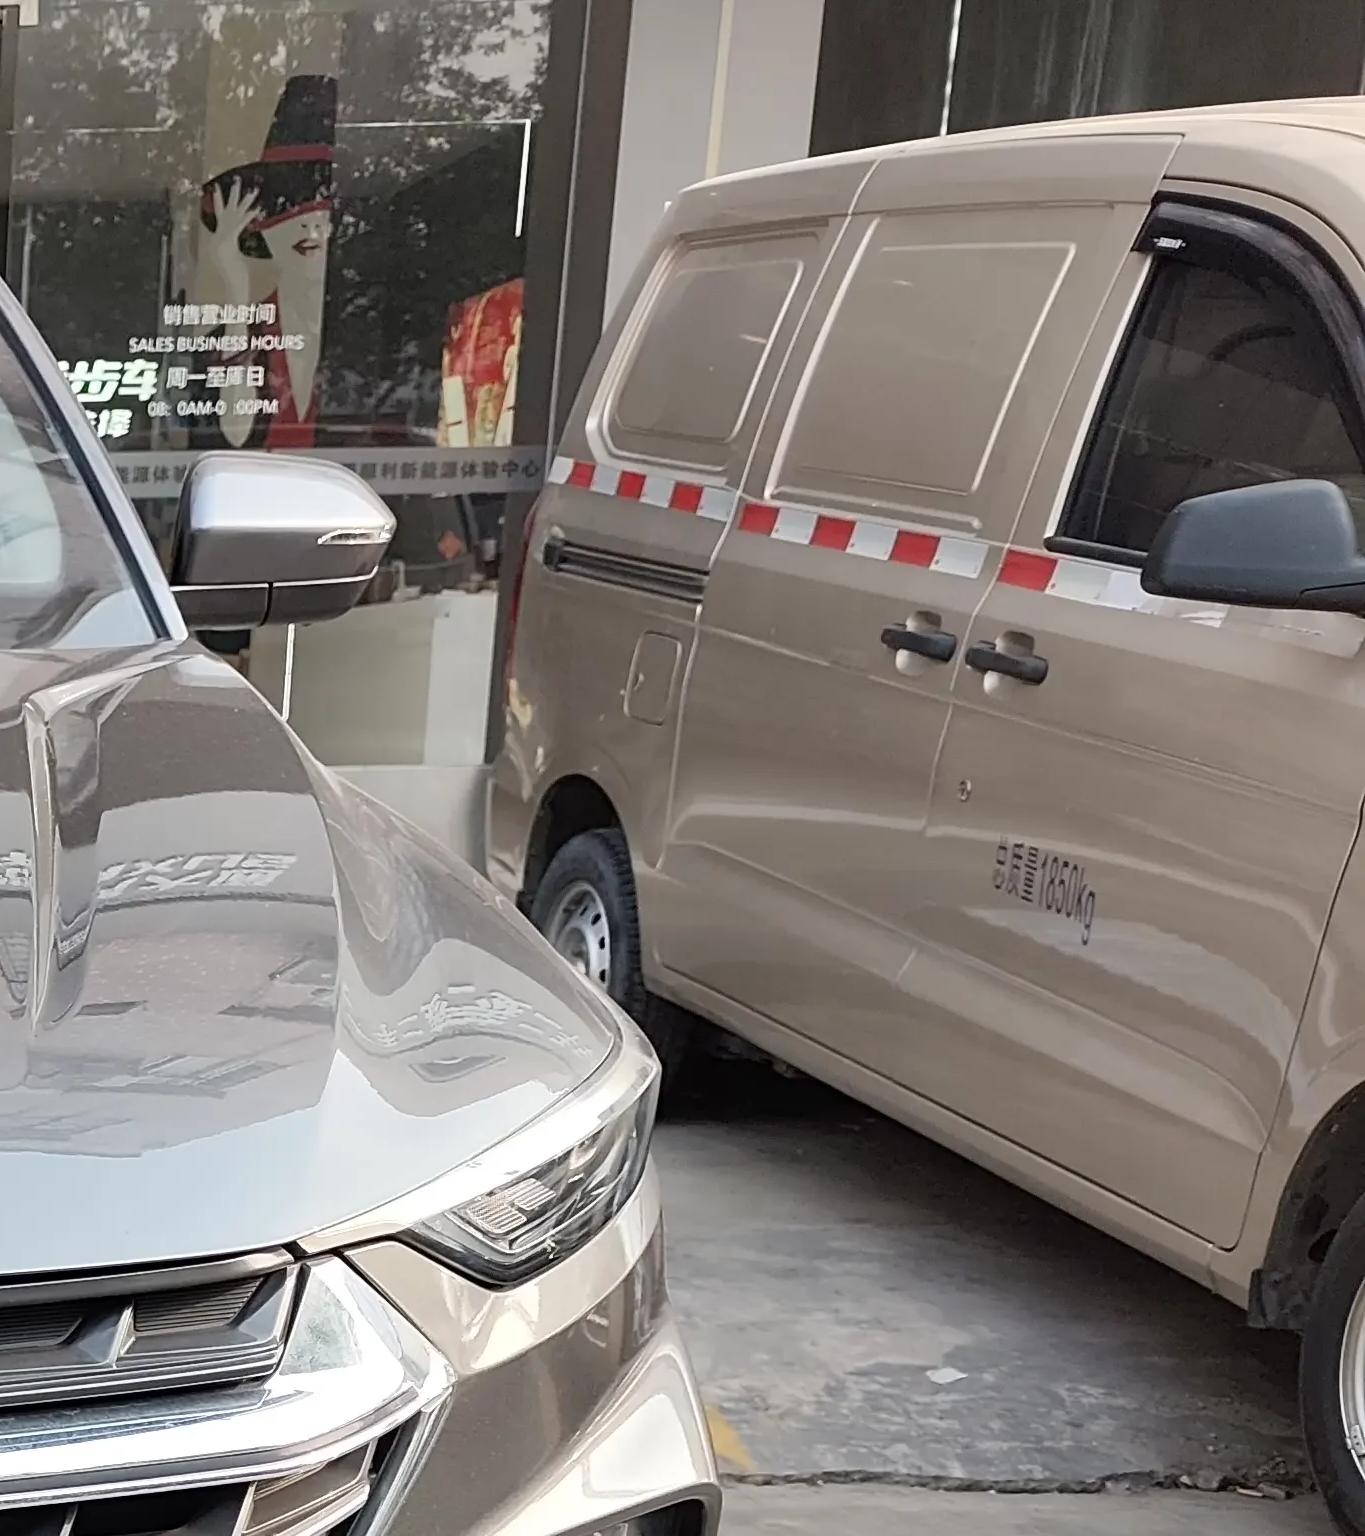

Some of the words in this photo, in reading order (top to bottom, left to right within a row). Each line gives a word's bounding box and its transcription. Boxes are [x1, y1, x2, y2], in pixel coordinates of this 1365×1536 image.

[163, 303, 276, 326] 销售营业时间
[129, 337, 175, 354] SALES
[177, 336, 248, 353] BUSINESS
[251, 335, 305, 351] HOURS
[57, 358, 159, 403] 步车
[166, 366, 265, 389] 周一至周日
